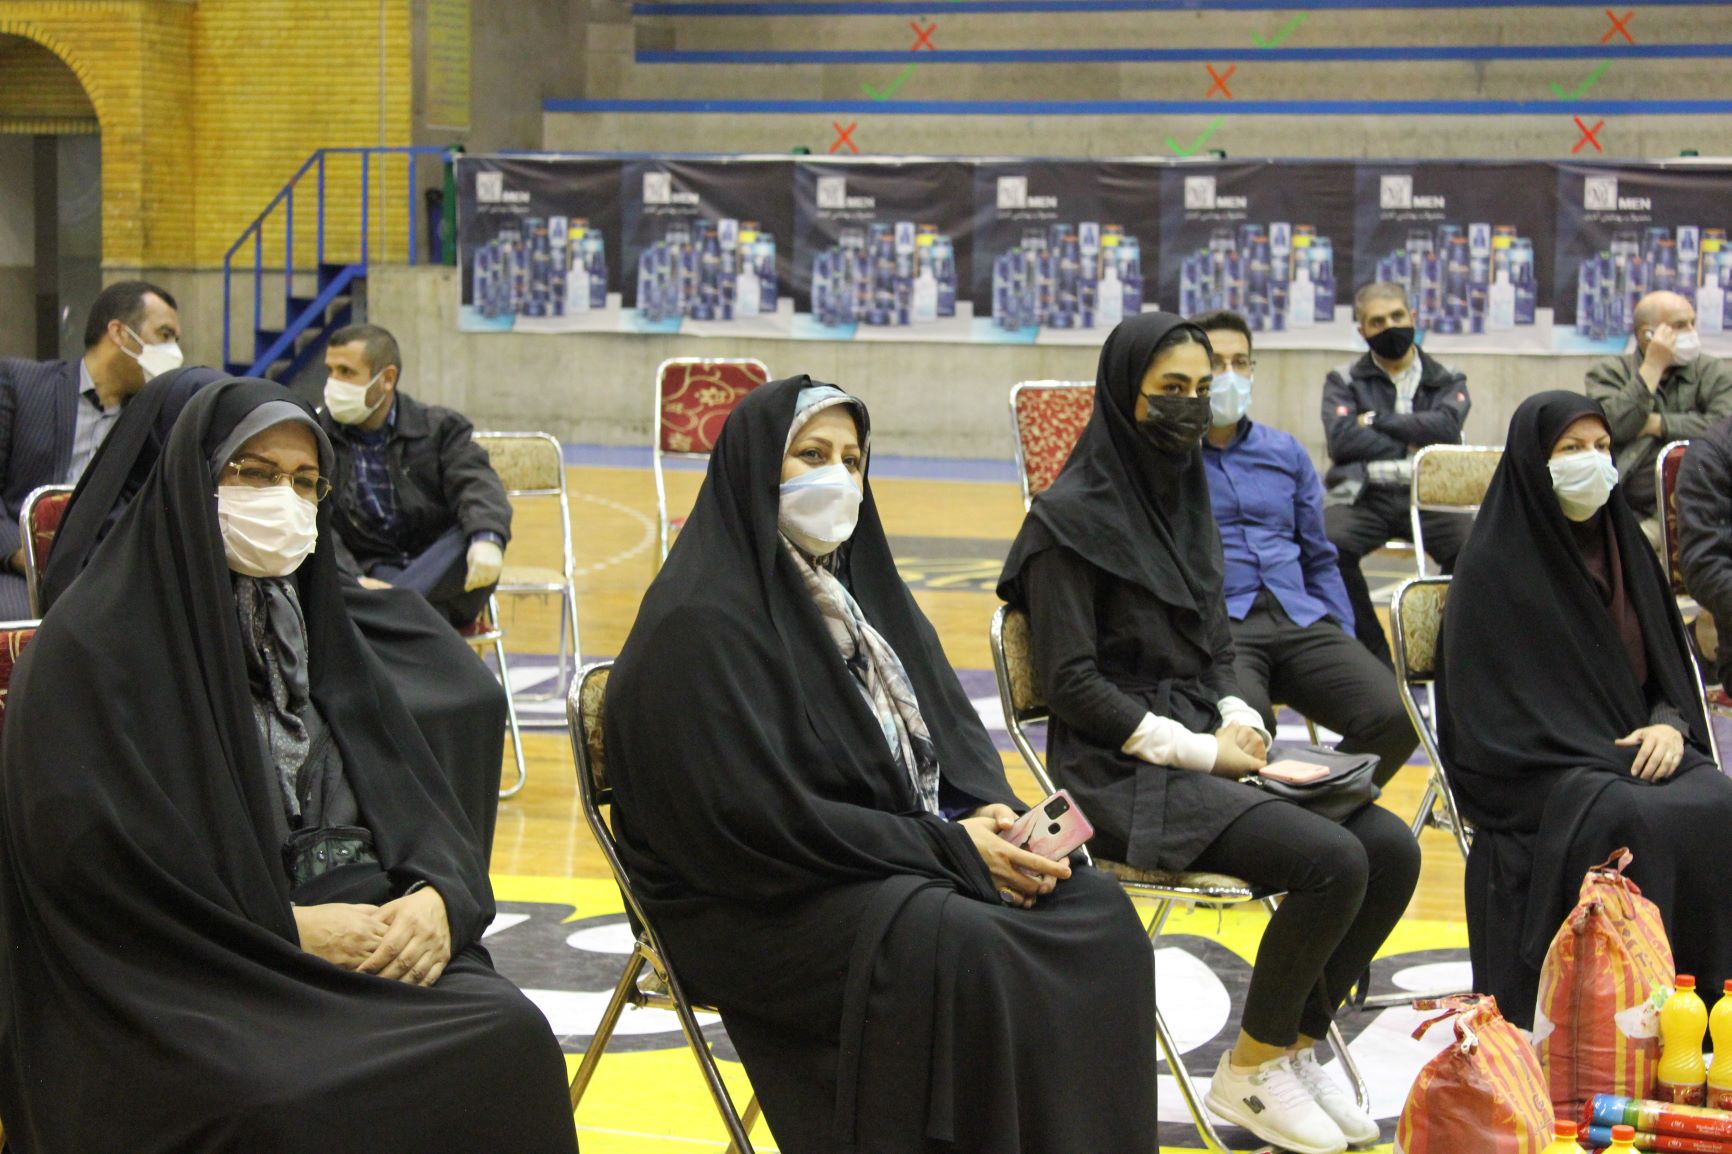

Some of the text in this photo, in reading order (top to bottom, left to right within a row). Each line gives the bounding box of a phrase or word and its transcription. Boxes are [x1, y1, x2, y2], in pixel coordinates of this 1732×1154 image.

[1216, 196, 1247, 209] MEN
[1413, 195, 1445, 209] MEN
[1618, 196, 1652, 211] MEN
